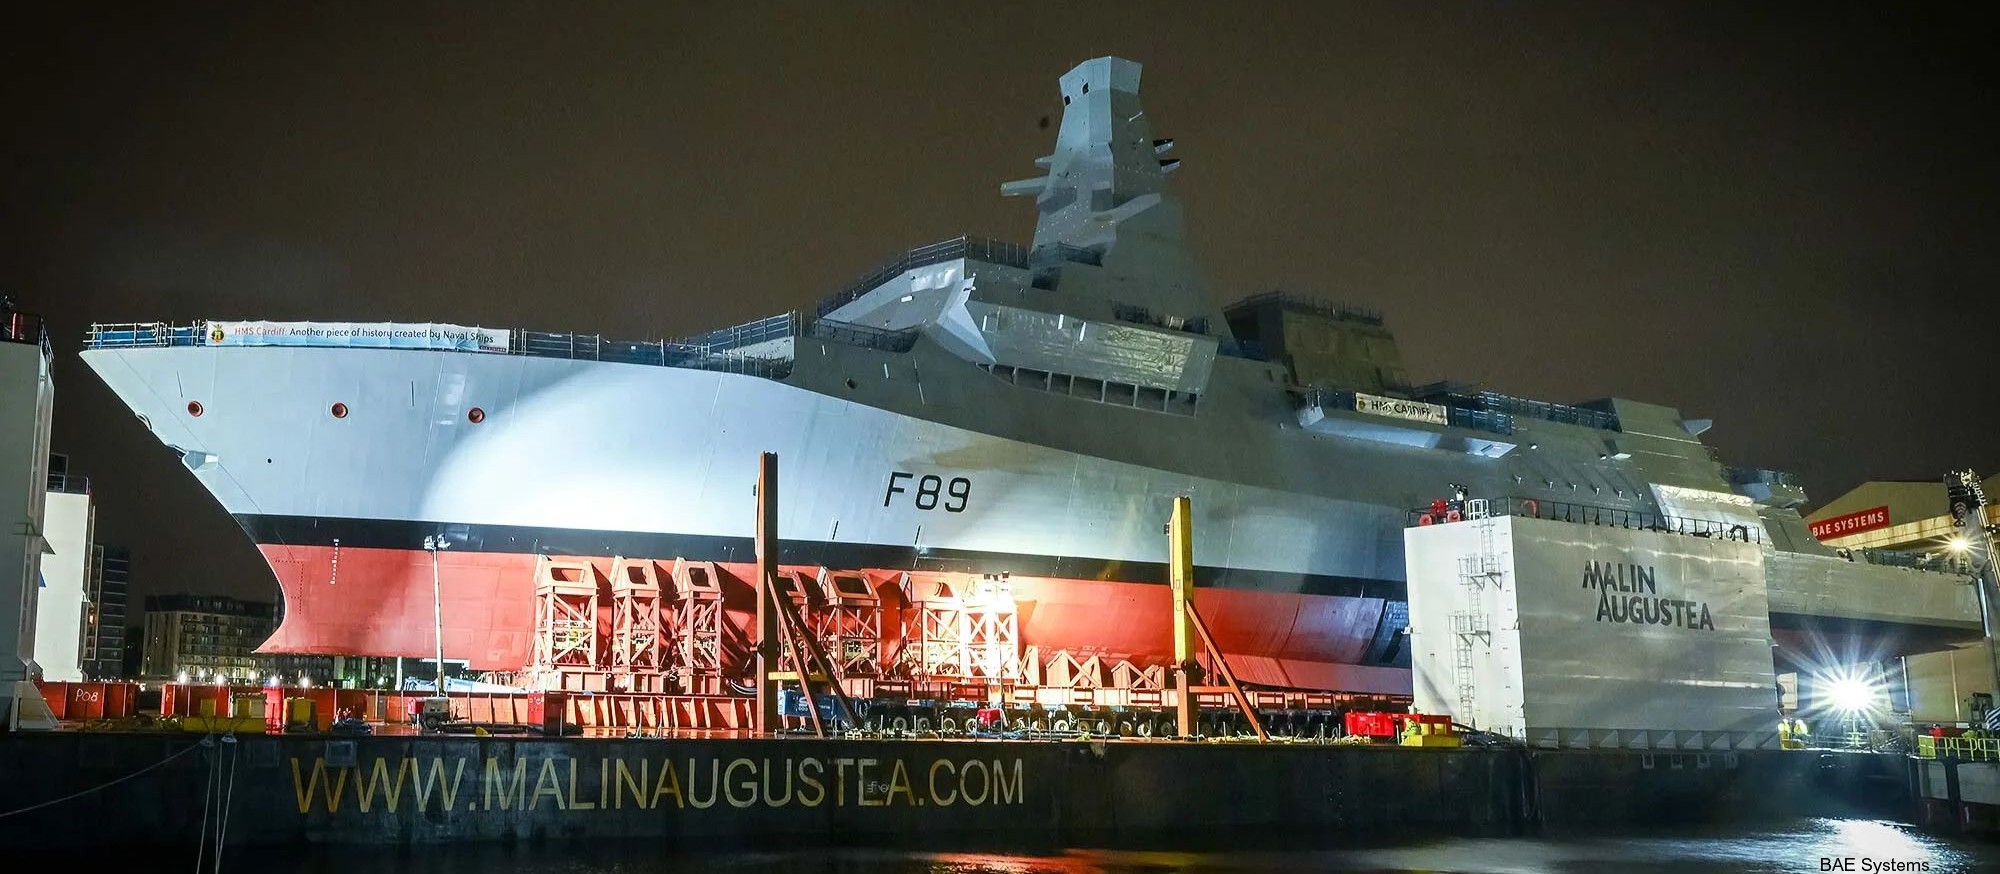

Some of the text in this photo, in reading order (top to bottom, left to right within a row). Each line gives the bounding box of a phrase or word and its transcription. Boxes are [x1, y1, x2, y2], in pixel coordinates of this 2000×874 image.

[234, 327, 494, 344] HMS Cardiff: Another piece of history created by Naval Ships
[1371, 401, 1392, 412] HMS
[883, 471, 971, 513] F89
[1812, 511, 1884, 537] BAE SYSTEMS
[1582, 560, 1656, 594] MALIN
[1596, 594, 1714, 631] AUGUSTEA
[291, 757, 1024, 813] WWW.MALINAUGUSTEA.COM
